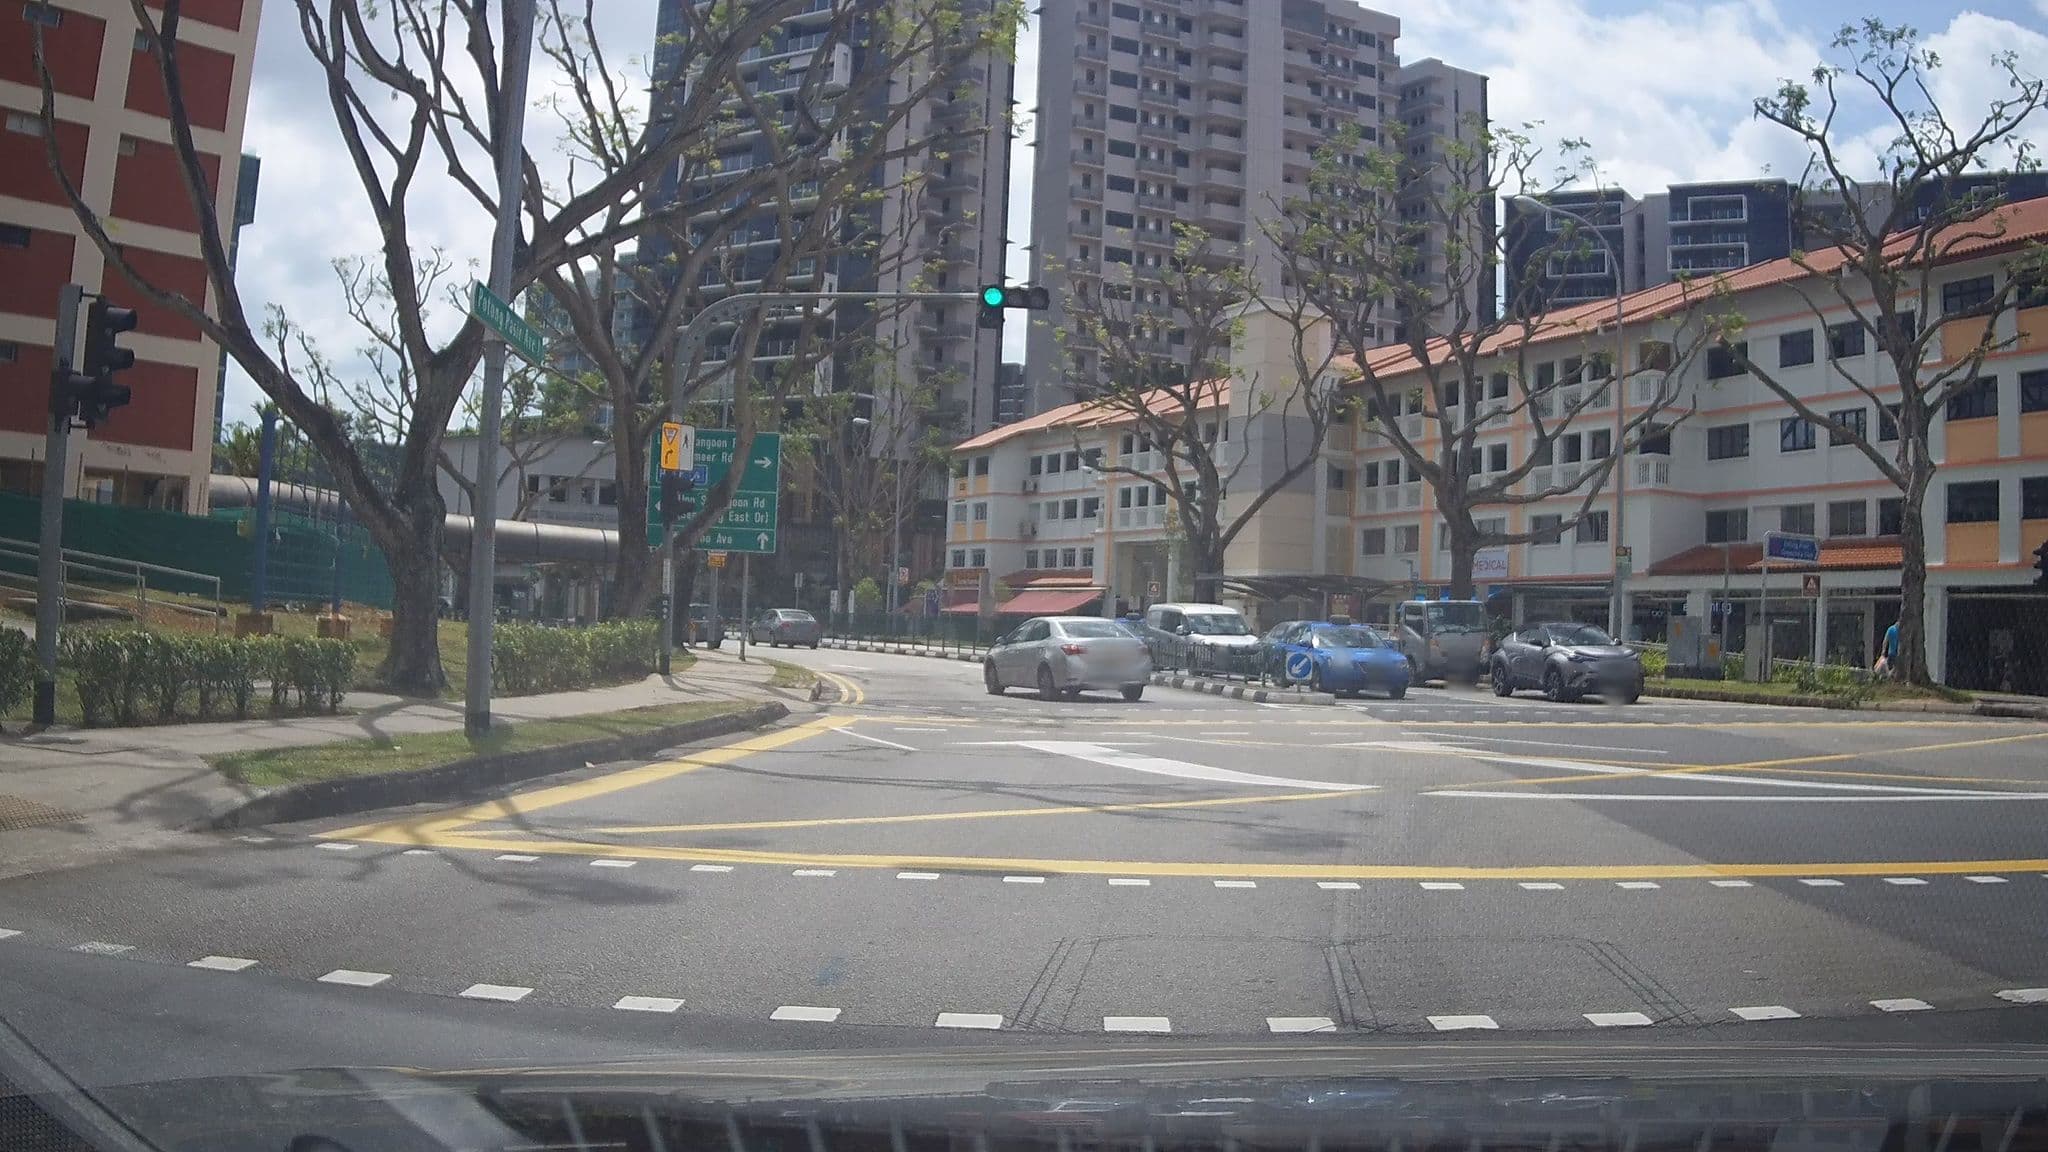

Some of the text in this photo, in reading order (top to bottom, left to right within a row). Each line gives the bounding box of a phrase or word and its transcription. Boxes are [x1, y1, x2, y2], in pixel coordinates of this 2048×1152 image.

[753, 497, 766, 508] Rd
[729, 511, 749, 522] East
[716, 532, 733, 544] Ave
